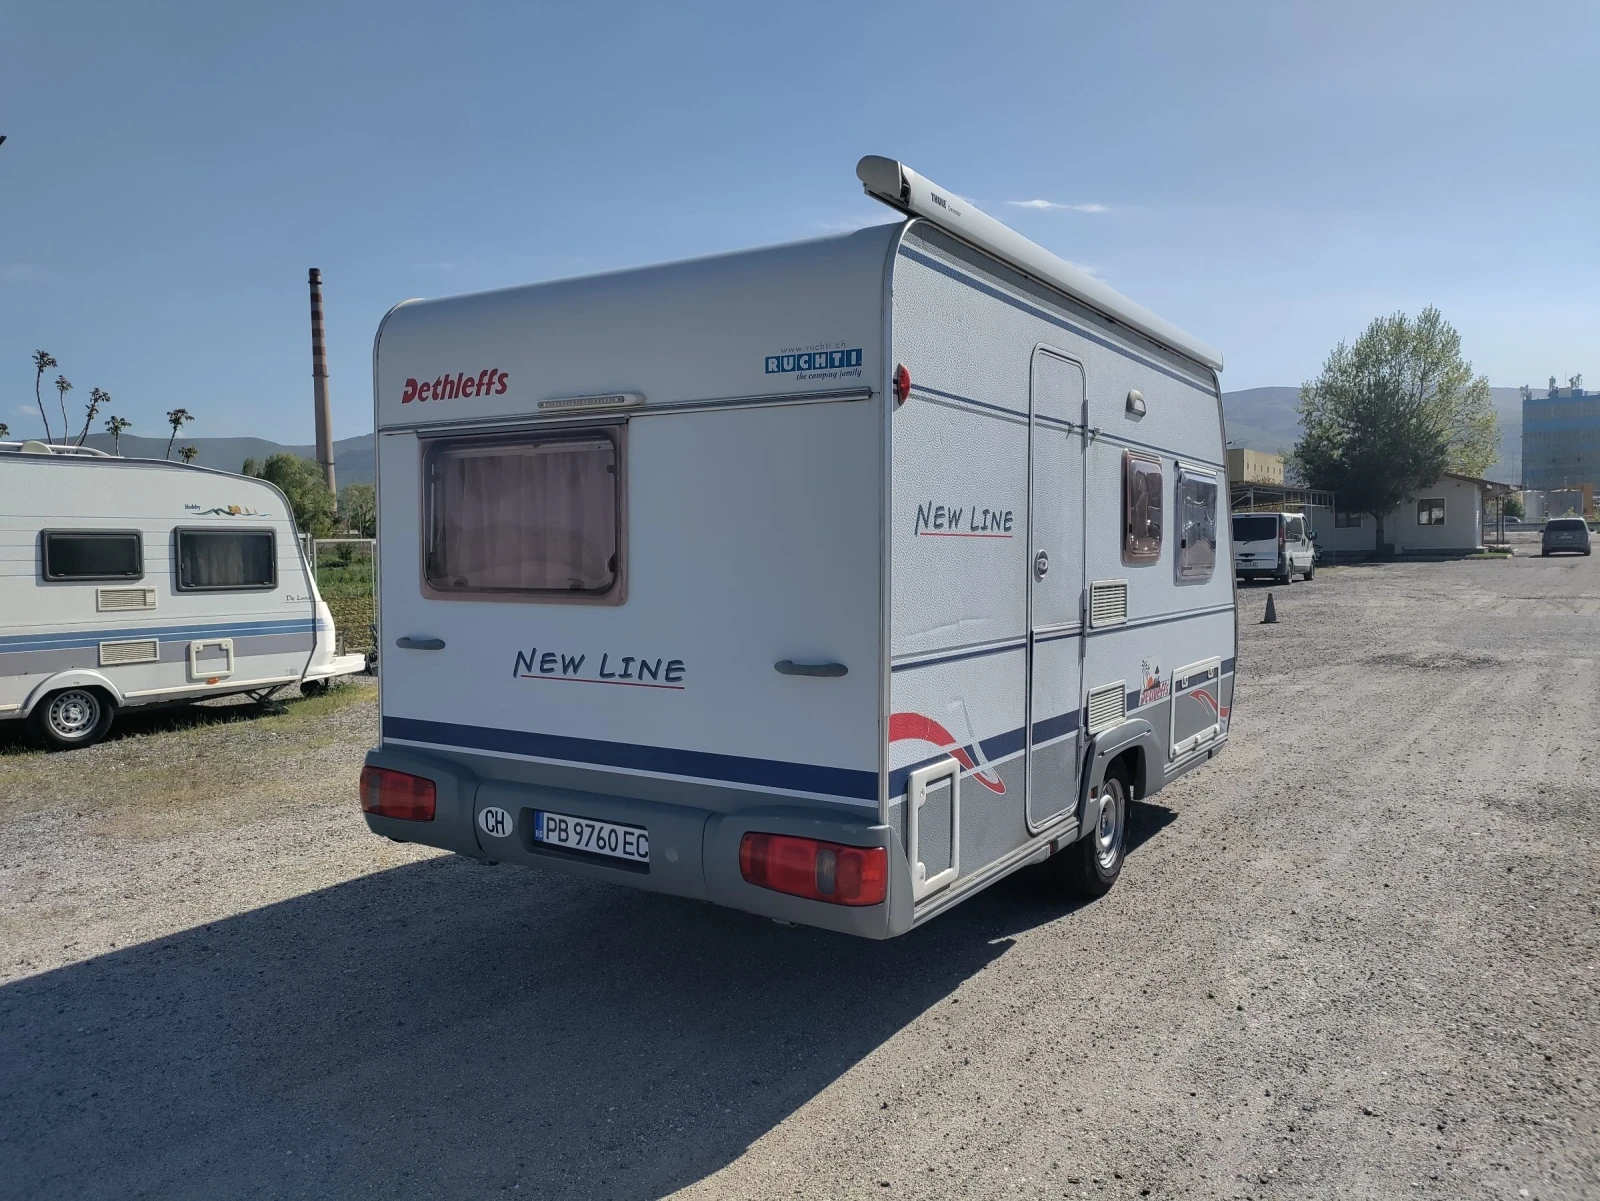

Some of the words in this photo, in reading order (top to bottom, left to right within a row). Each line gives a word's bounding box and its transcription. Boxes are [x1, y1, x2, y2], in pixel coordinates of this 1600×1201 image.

[930, 192, 947, 209] THULE
[780, 340, 846, 353] www.ruchtich
[766, 350, 859, 373] RUCHTI
[796, 371, 807, 380] the
[808, 370, 838, 380] camping
[839, 367, 862, 379] family
[402, 368, 509, 404] Dethleffs
[184, 503, 201, 511] Hobby
[914, 500, 963, 537] NEW
[970, 505, 1014, 532] LINE
[512, 647, 586, 678] NEW
[599, 652, 687, 683] LINE
[485, 809, 506, 835] CH
[546, 816, 569, 843] PB
[573, 822, 619, 853] 9760
[622, 831, 649, 859] EC
